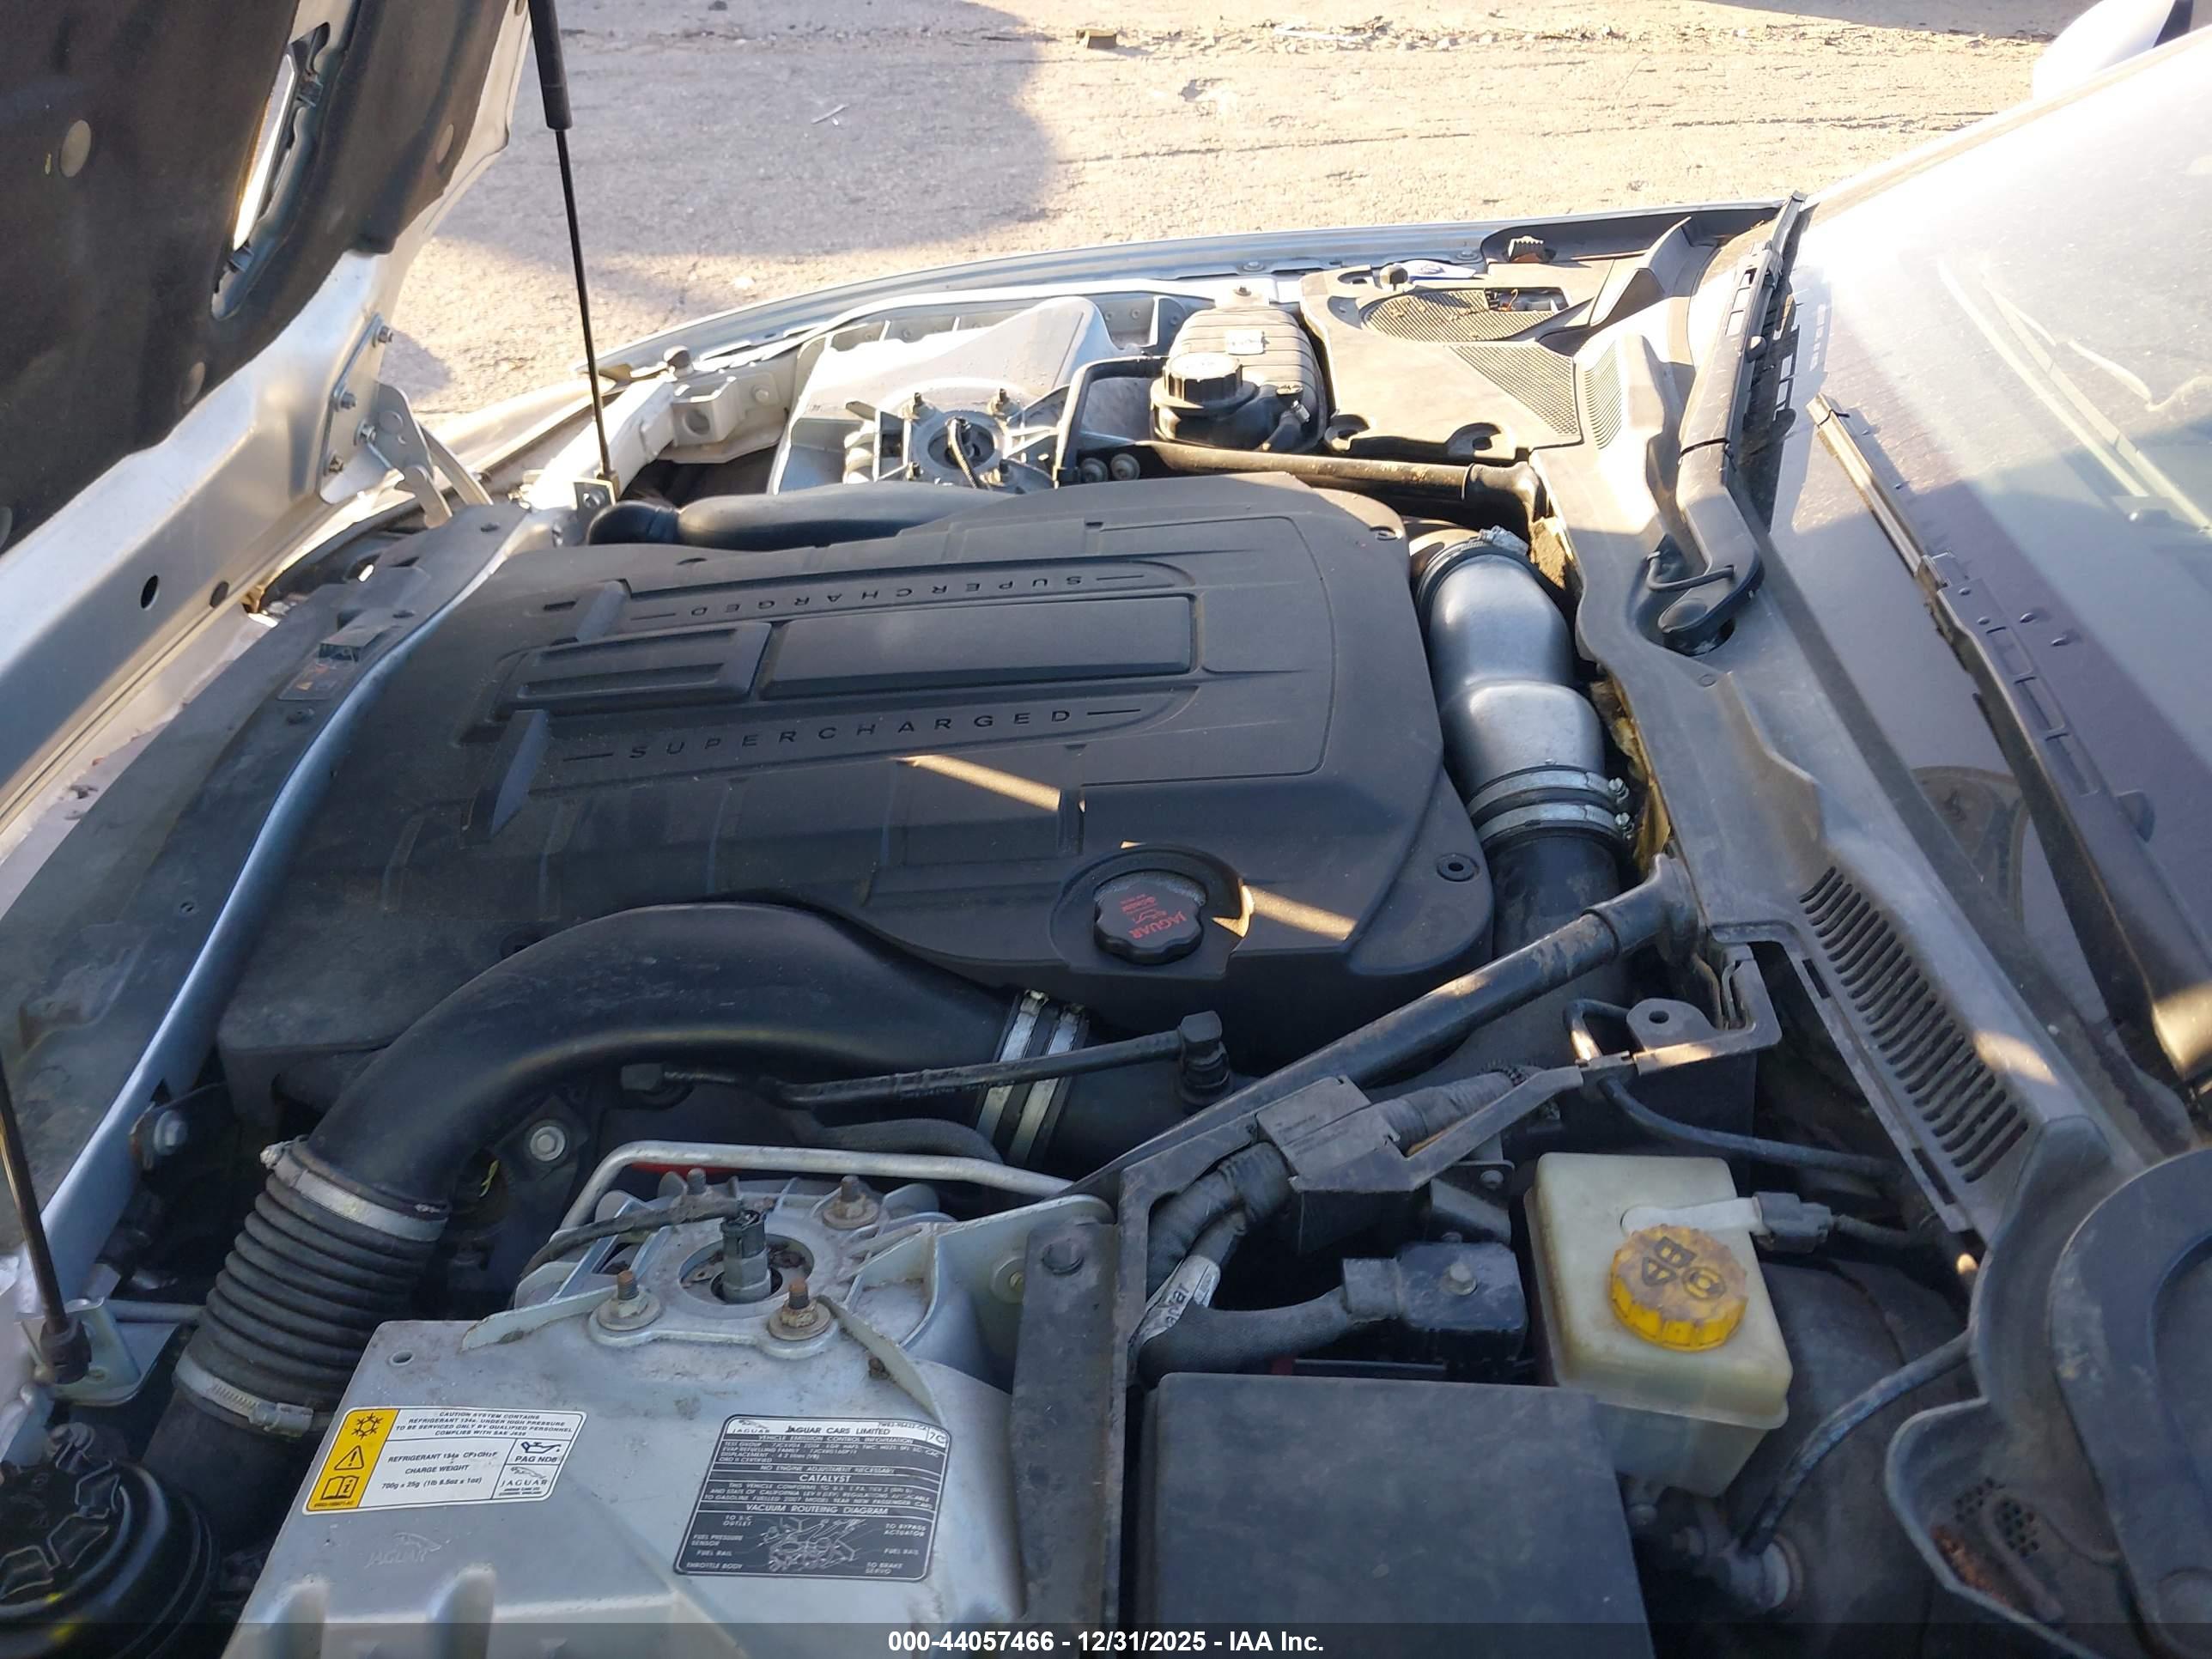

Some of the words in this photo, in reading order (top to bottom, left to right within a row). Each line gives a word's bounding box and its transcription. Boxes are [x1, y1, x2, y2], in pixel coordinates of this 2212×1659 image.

[689, 574, 1082, 617] SUPERCHARGED
[629, 708, 1072, 760] SUPERCHARGED
[1128, 911, 1187, 939] JAGUAR
[784, 1425, 821, 1434] JAGUAR
[387, 1453, 441, 1462] REFRIGERANT
[440, 1464, 471, 1473] WEIGHT
[799, 1474, 852, 1483] CATALYST
[745, 1504, 787, 1512] VACUUM
[790, 1505, 839, 1514] ROUTEING
[842, 1506, 890, 1515] DIAGRAM
